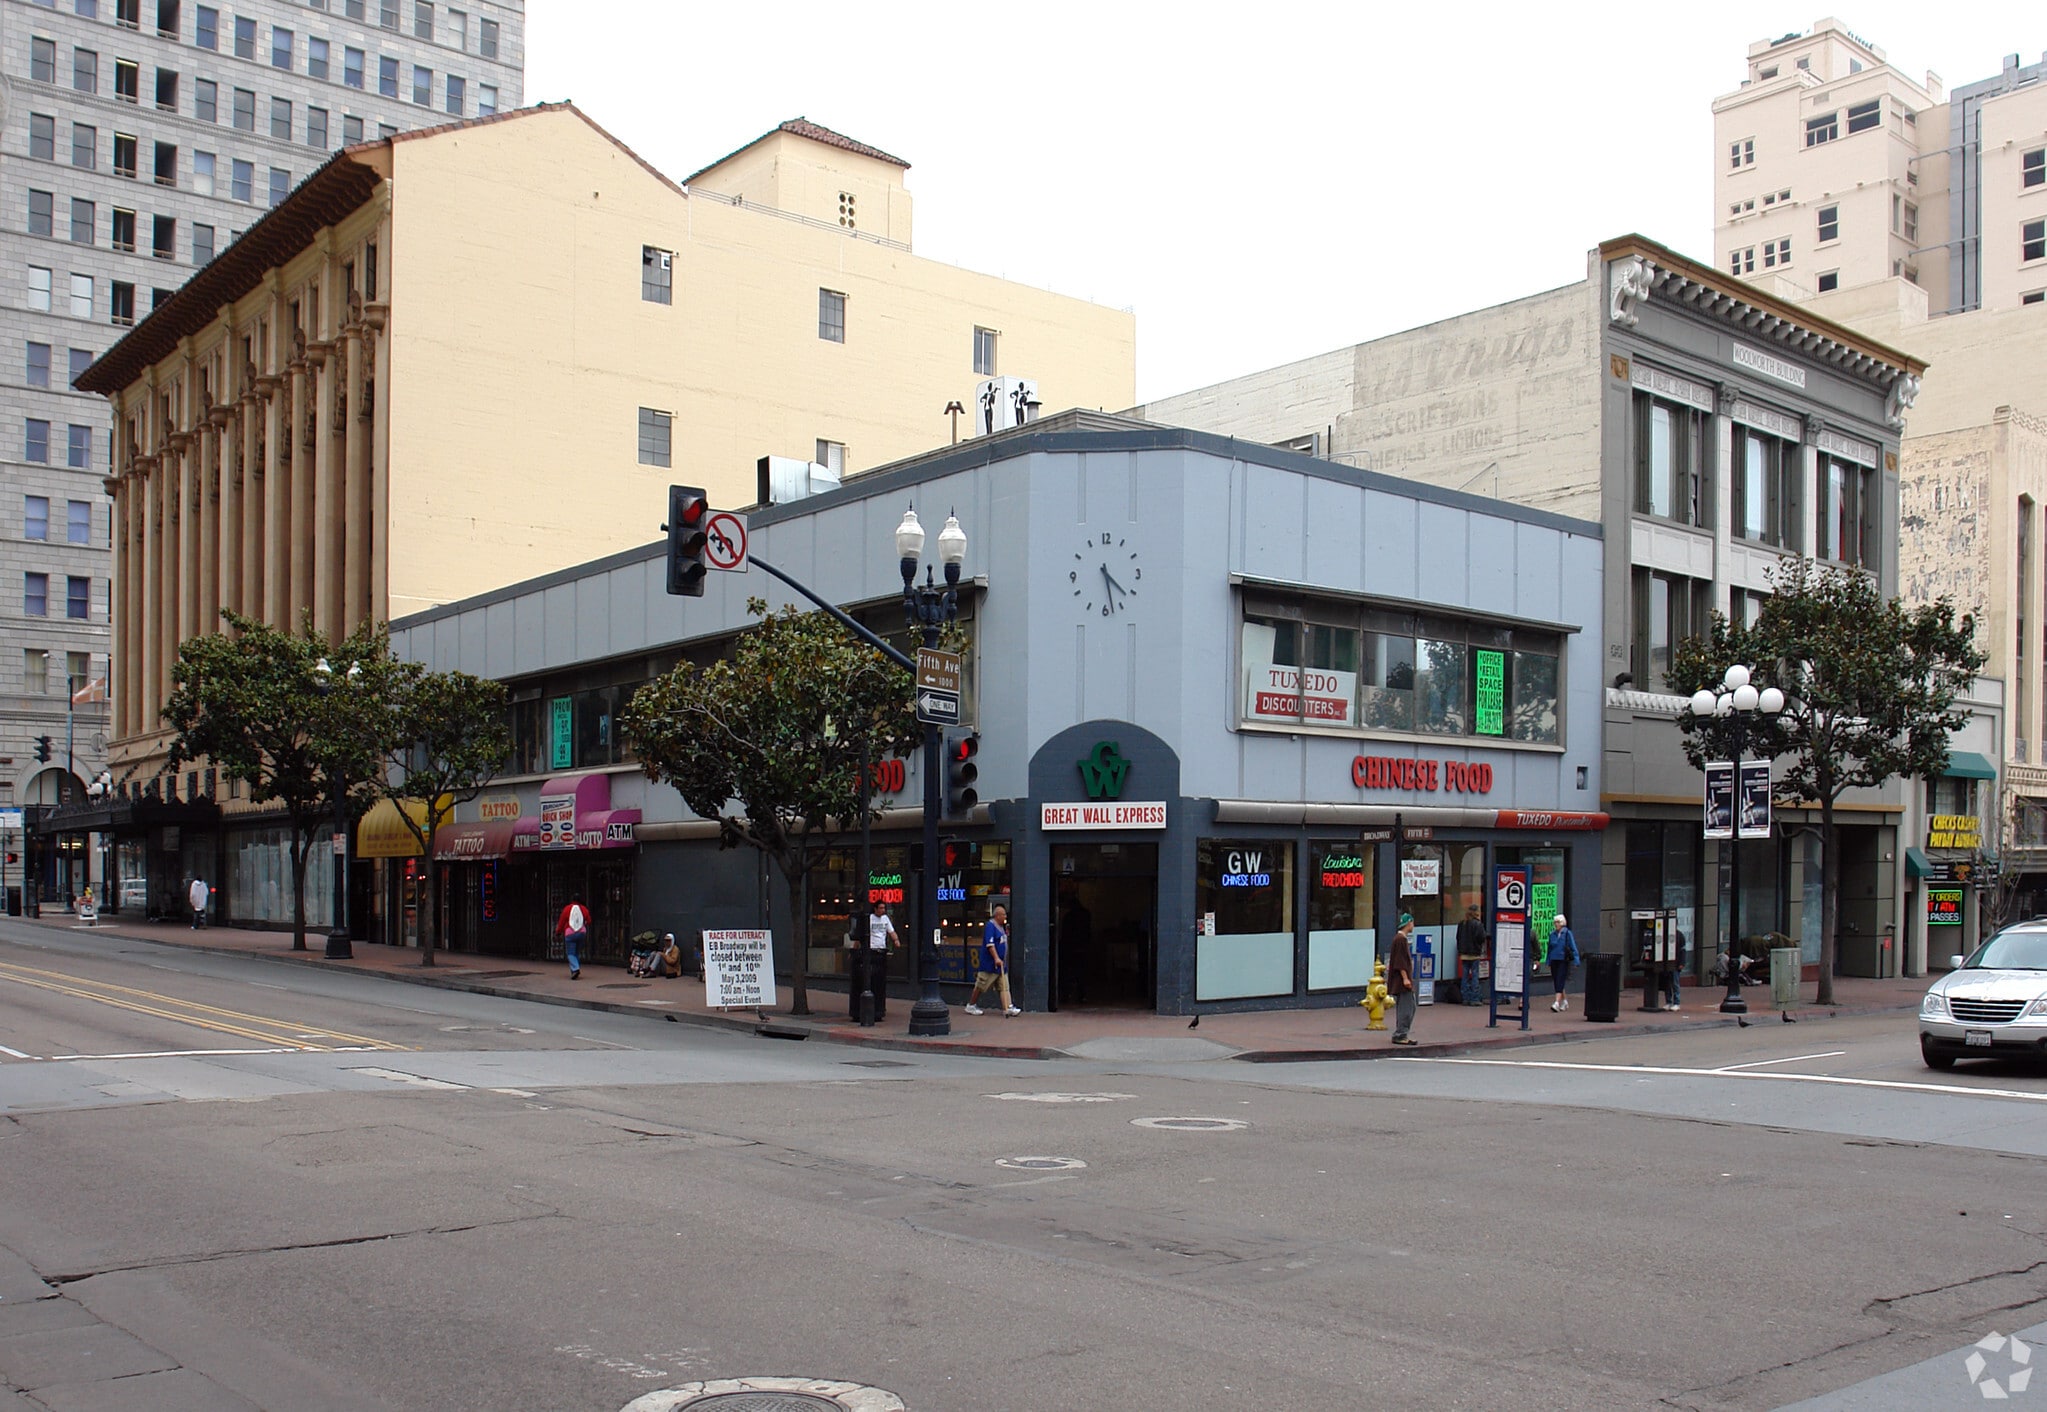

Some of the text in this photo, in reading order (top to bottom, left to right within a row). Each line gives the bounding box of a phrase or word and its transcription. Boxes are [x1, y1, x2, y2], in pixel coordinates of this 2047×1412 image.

[1734, 345, 1804, 386] WOOLWORTH BUILDING
[1102, 532, 1111, 545] 12
[1069, 571, 1077, 583] 9
[1135, 568, 1141, 580] 3
[1102, 604, 1109, 617] 6
[918, 654, 960, 674] Fifth Ave
[939, 676, 954, 688] 1000
[1268, 670, 1338, 693] TUXEDO
[1479, 677, 1502, 691] SPACE
[930, 699, 954, 712] ONE WAY
[1352, 755, 1493, 793] CHINESE FOOD
[482, 803, 518, 817] TATTOO
[1044, 807, 1164, 825] GREAT WALL EXPRESS
[1517, 813, 1552, 826] TUXEDO
[1933, 815, 1956, 830] CHECKS
[606, 823, 633, 840] ATM
[1364, 831, 1391, 840] BROADWAY
[1408, 829, 1422, 838] FIFTH
[514, 835, 530, 848] ATM
[579, 831, 602, 846] LOTTO
[453, 838, 484, 853] TATTOO
[1323, 854, 1362, 869] Louisiana
[869, 871, 902, 885] ouisiana
[1222, 874, 1269, 886] CHINESE FOOD
[1322, 873, 1339, 887] FRIED
[1537, 885, 1555, 897] OFFICE
[1936, 892, 1960, 902] ORDERS
[1940, 902, 1956, 912] ATM
[1534, 909, 1556, 921] SPACE
[1930, 912, 1959, 921] PASSES
[709, 931, 766, 939] RACE FOR LITERACY
[720, 941, 747, 952] Broadway
[748, 941, 758, 950] will
[759, 941, 766, 950] be
[711, 951, 762, 962] closed between
[729, 963, 741, 971] and
[746, 963, 760, 971] 10th
[721, 974, 734, 984] May
[720, 985, 732, 994] 7:00
[733, 986, 741, 994] am
[746, 984, 760, 994] Noon
[721, 996, 761, 1005] Special Event
